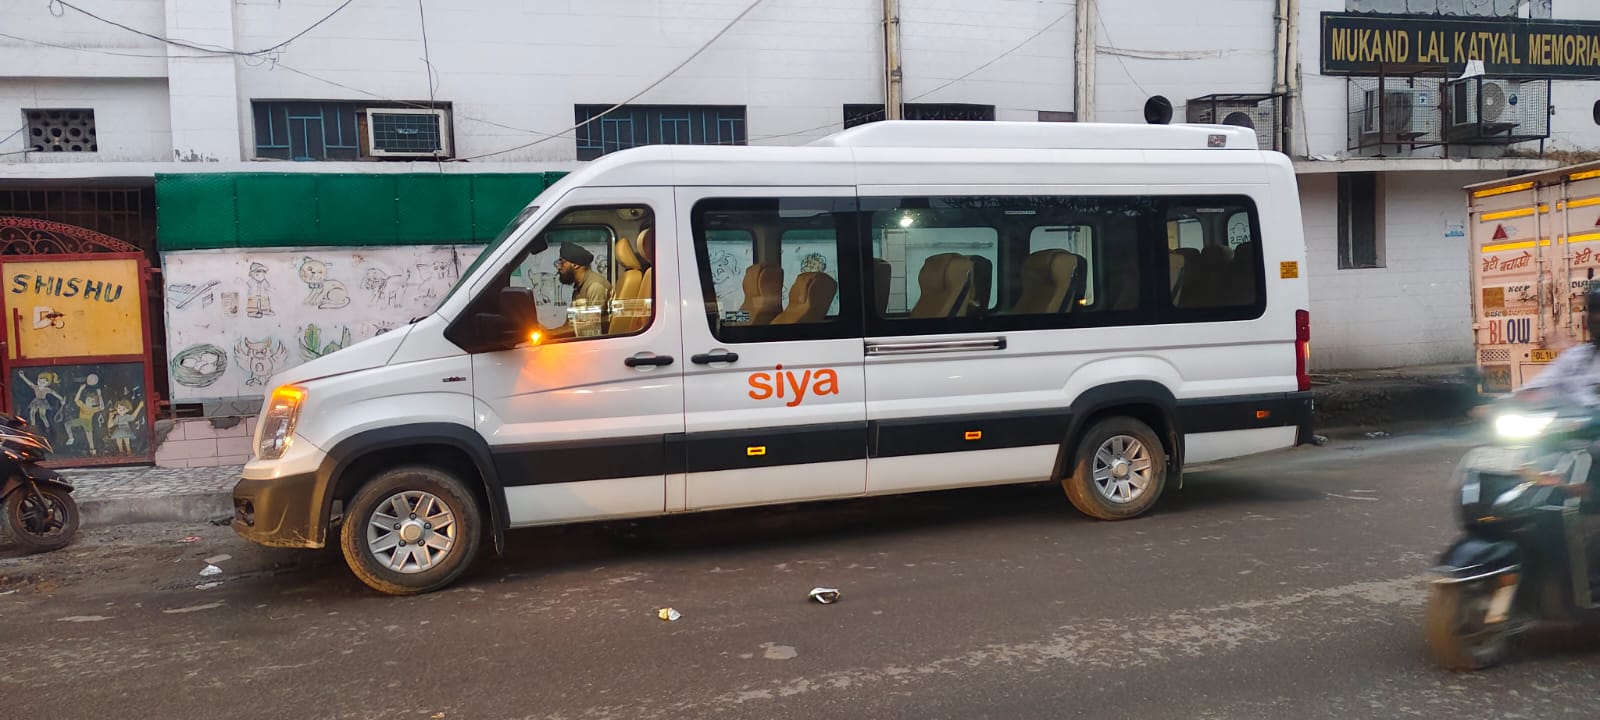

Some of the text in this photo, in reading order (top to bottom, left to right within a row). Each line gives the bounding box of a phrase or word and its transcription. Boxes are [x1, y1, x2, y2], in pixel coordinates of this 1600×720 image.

[1332, 28, 1600, 66] MUKAND LAL KATYAL MEMORIA
[11, 274, 123, 302] SHISHU
[1489, 319, 1530, 344] BLOW
[748, 364, 839, 407] siya
